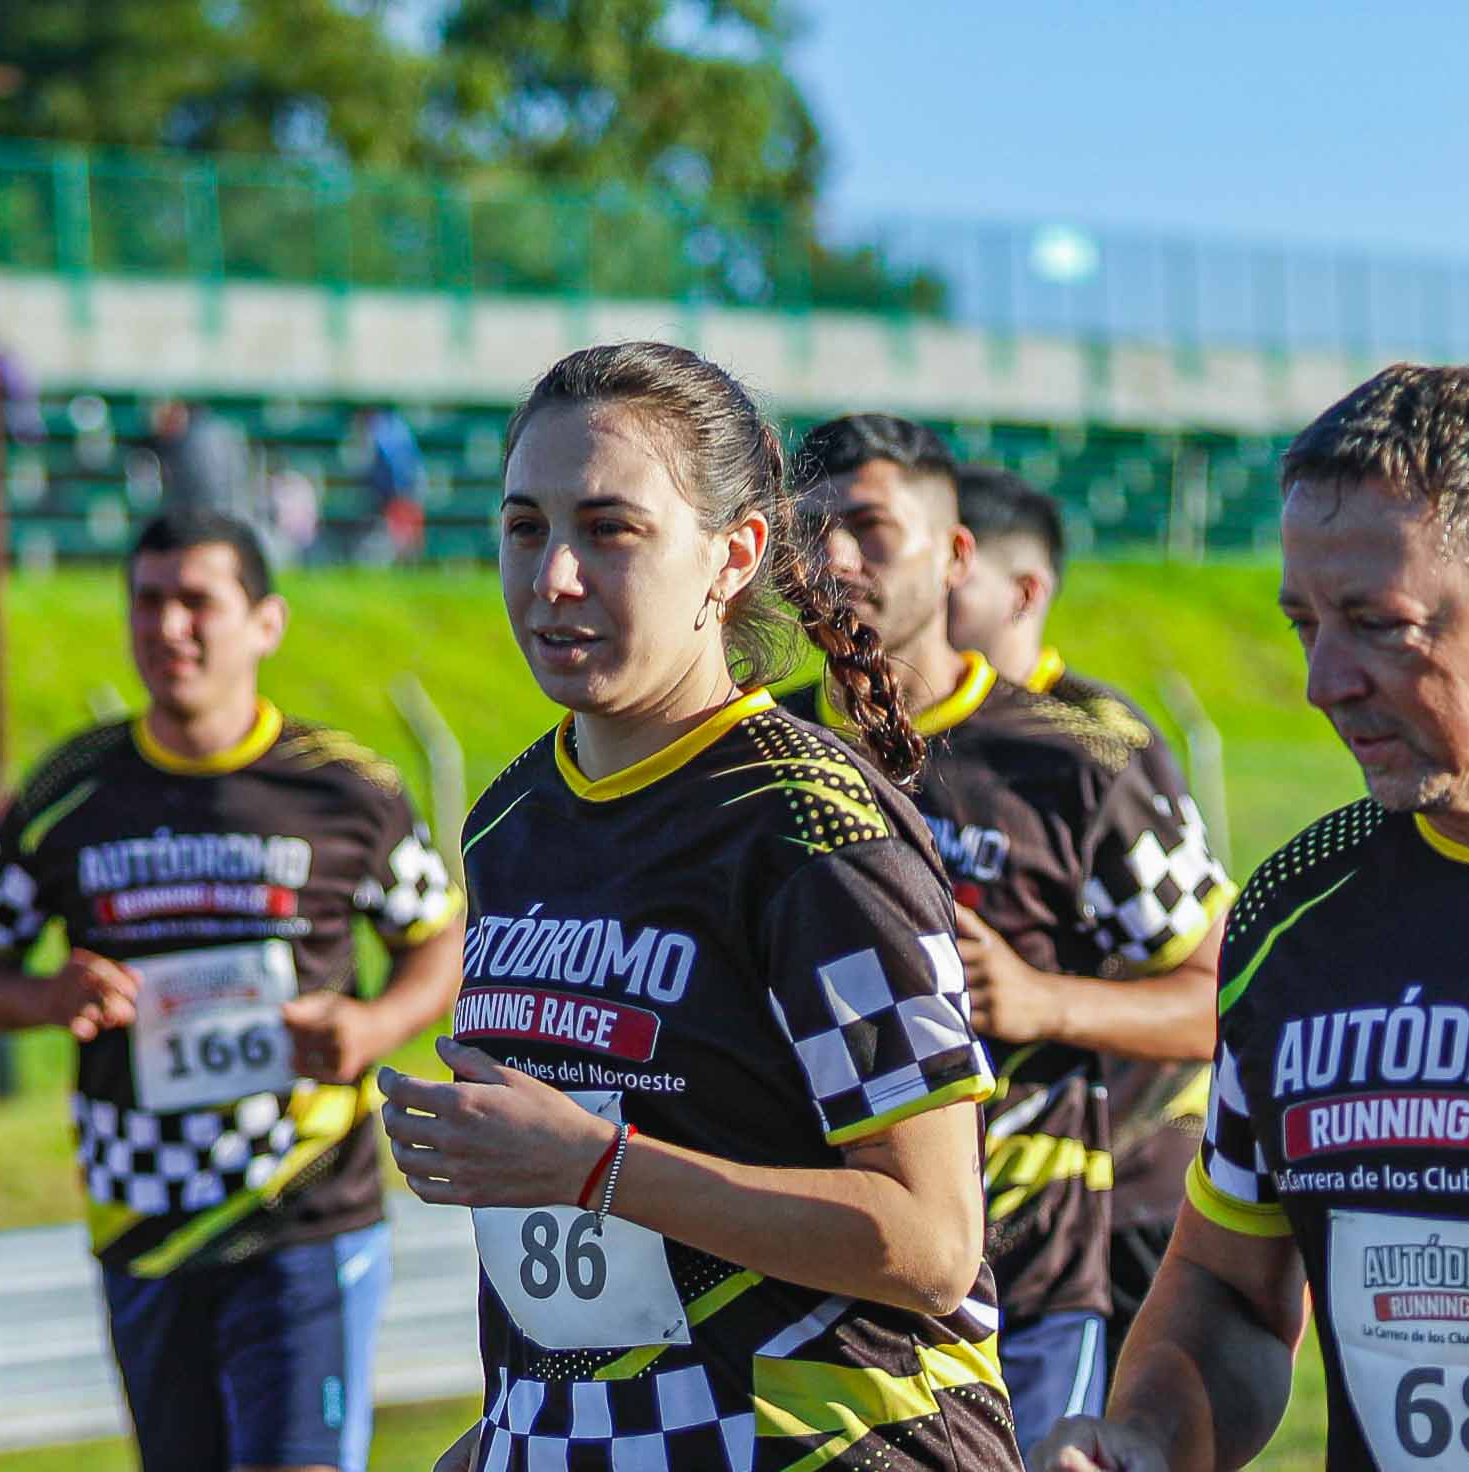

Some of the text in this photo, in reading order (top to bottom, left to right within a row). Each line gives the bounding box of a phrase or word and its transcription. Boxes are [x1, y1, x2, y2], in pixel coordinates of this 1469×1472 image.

[539, 997, 618, 1048] RACE
[166, 1026, 272, 1080] 166
[558, 1060, 585, 1084] del
[589, 1064, 686, 1092] Noroeste
[1350, 1164, 1379, 1190] de
[1383, 1165, 1419, 1190] los
[518, 1211, 608, 1300] 86
[1411, 1328, 1424, 1343] de
[1428, 1331, 1445, 1345] los
